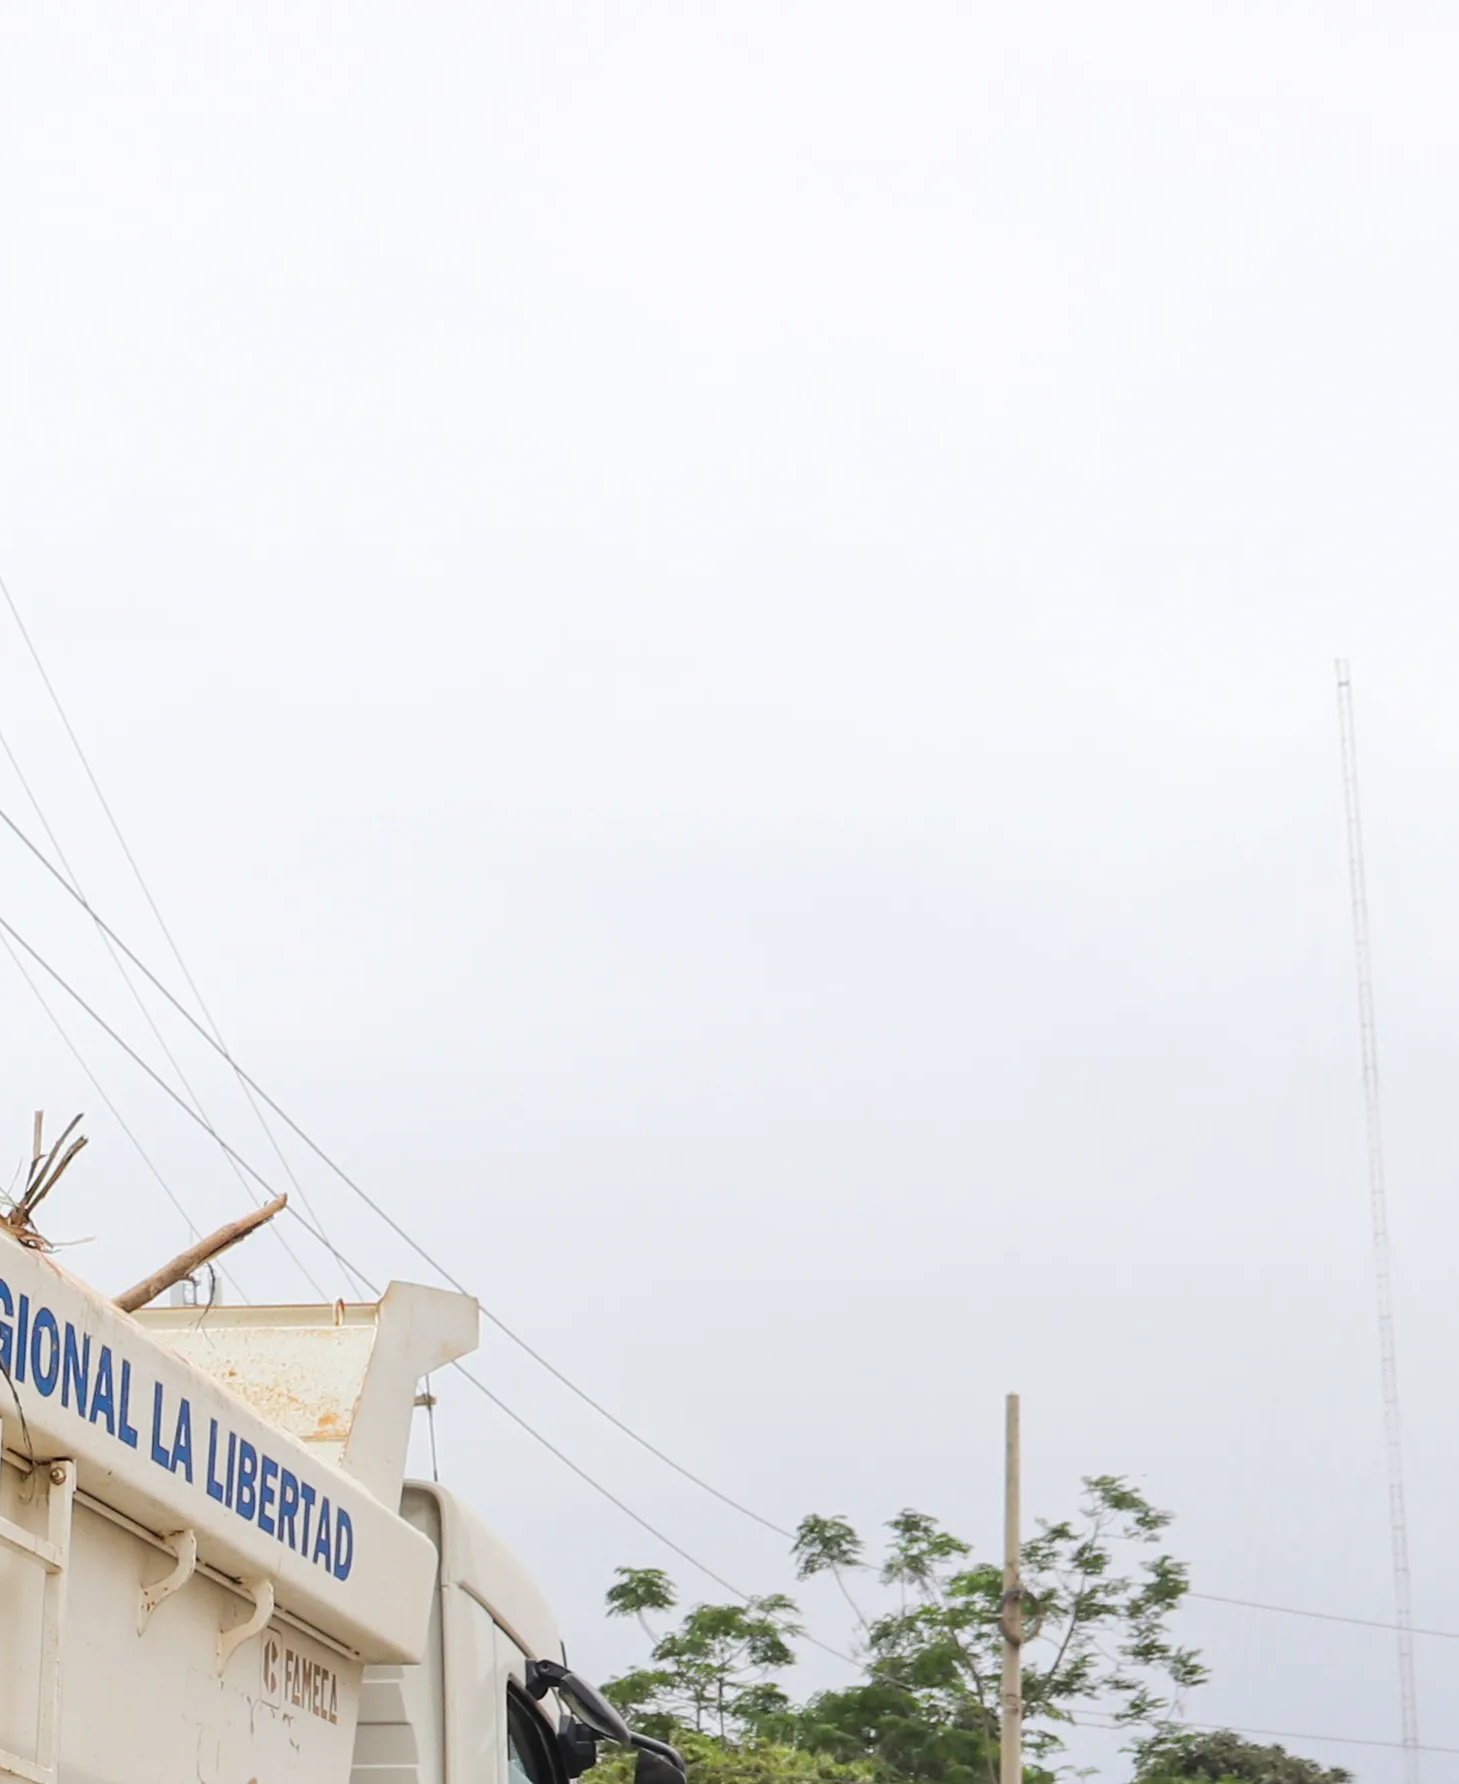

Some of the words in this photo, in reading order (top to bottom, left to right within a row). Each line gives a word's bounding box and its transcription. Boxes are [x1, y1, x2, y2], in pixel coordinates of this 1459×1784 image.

[150, 1381, 194, 1484] LA
[206, 1418, 354, 1582] LIBERTAD
[285, 1648, 338, 1726] FAMECA
